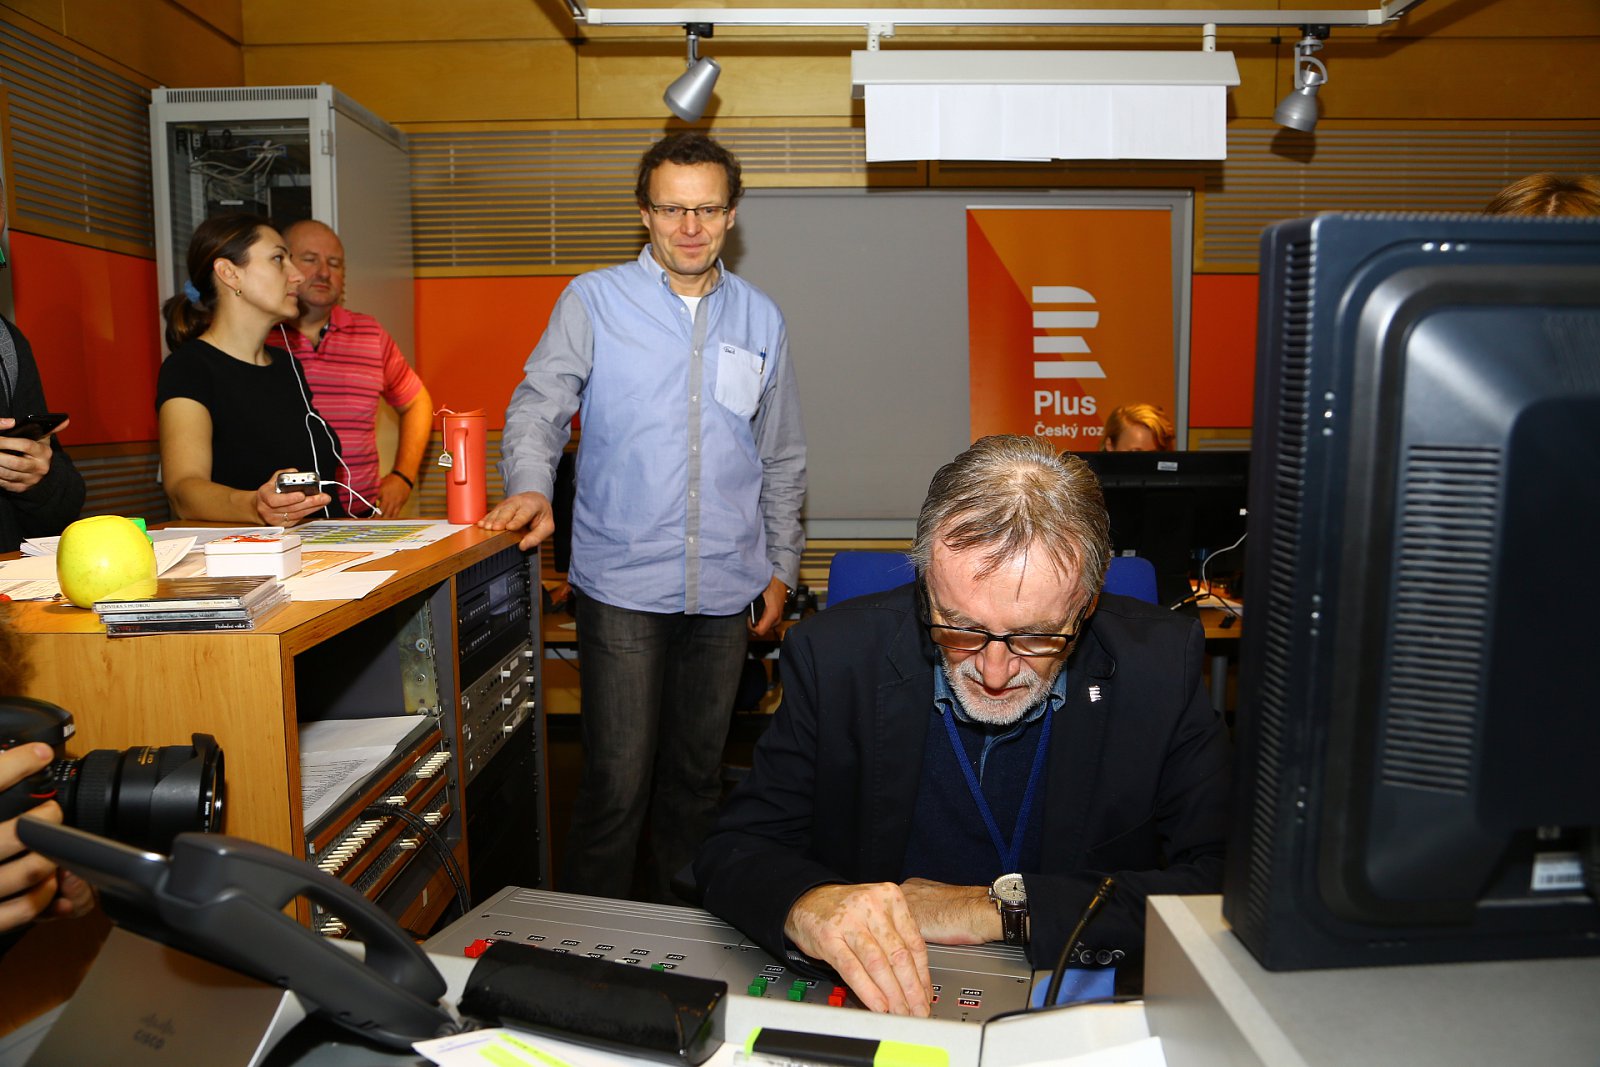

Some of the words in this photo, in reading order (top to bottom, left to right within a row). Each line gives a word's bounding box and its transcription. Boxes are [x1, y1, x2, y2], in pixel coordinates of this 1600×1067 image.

[1034, 390, 1096, 415] Plus
[1034, 421, 1079, 439] Český
[1083, 424, 1104, 436] roz
